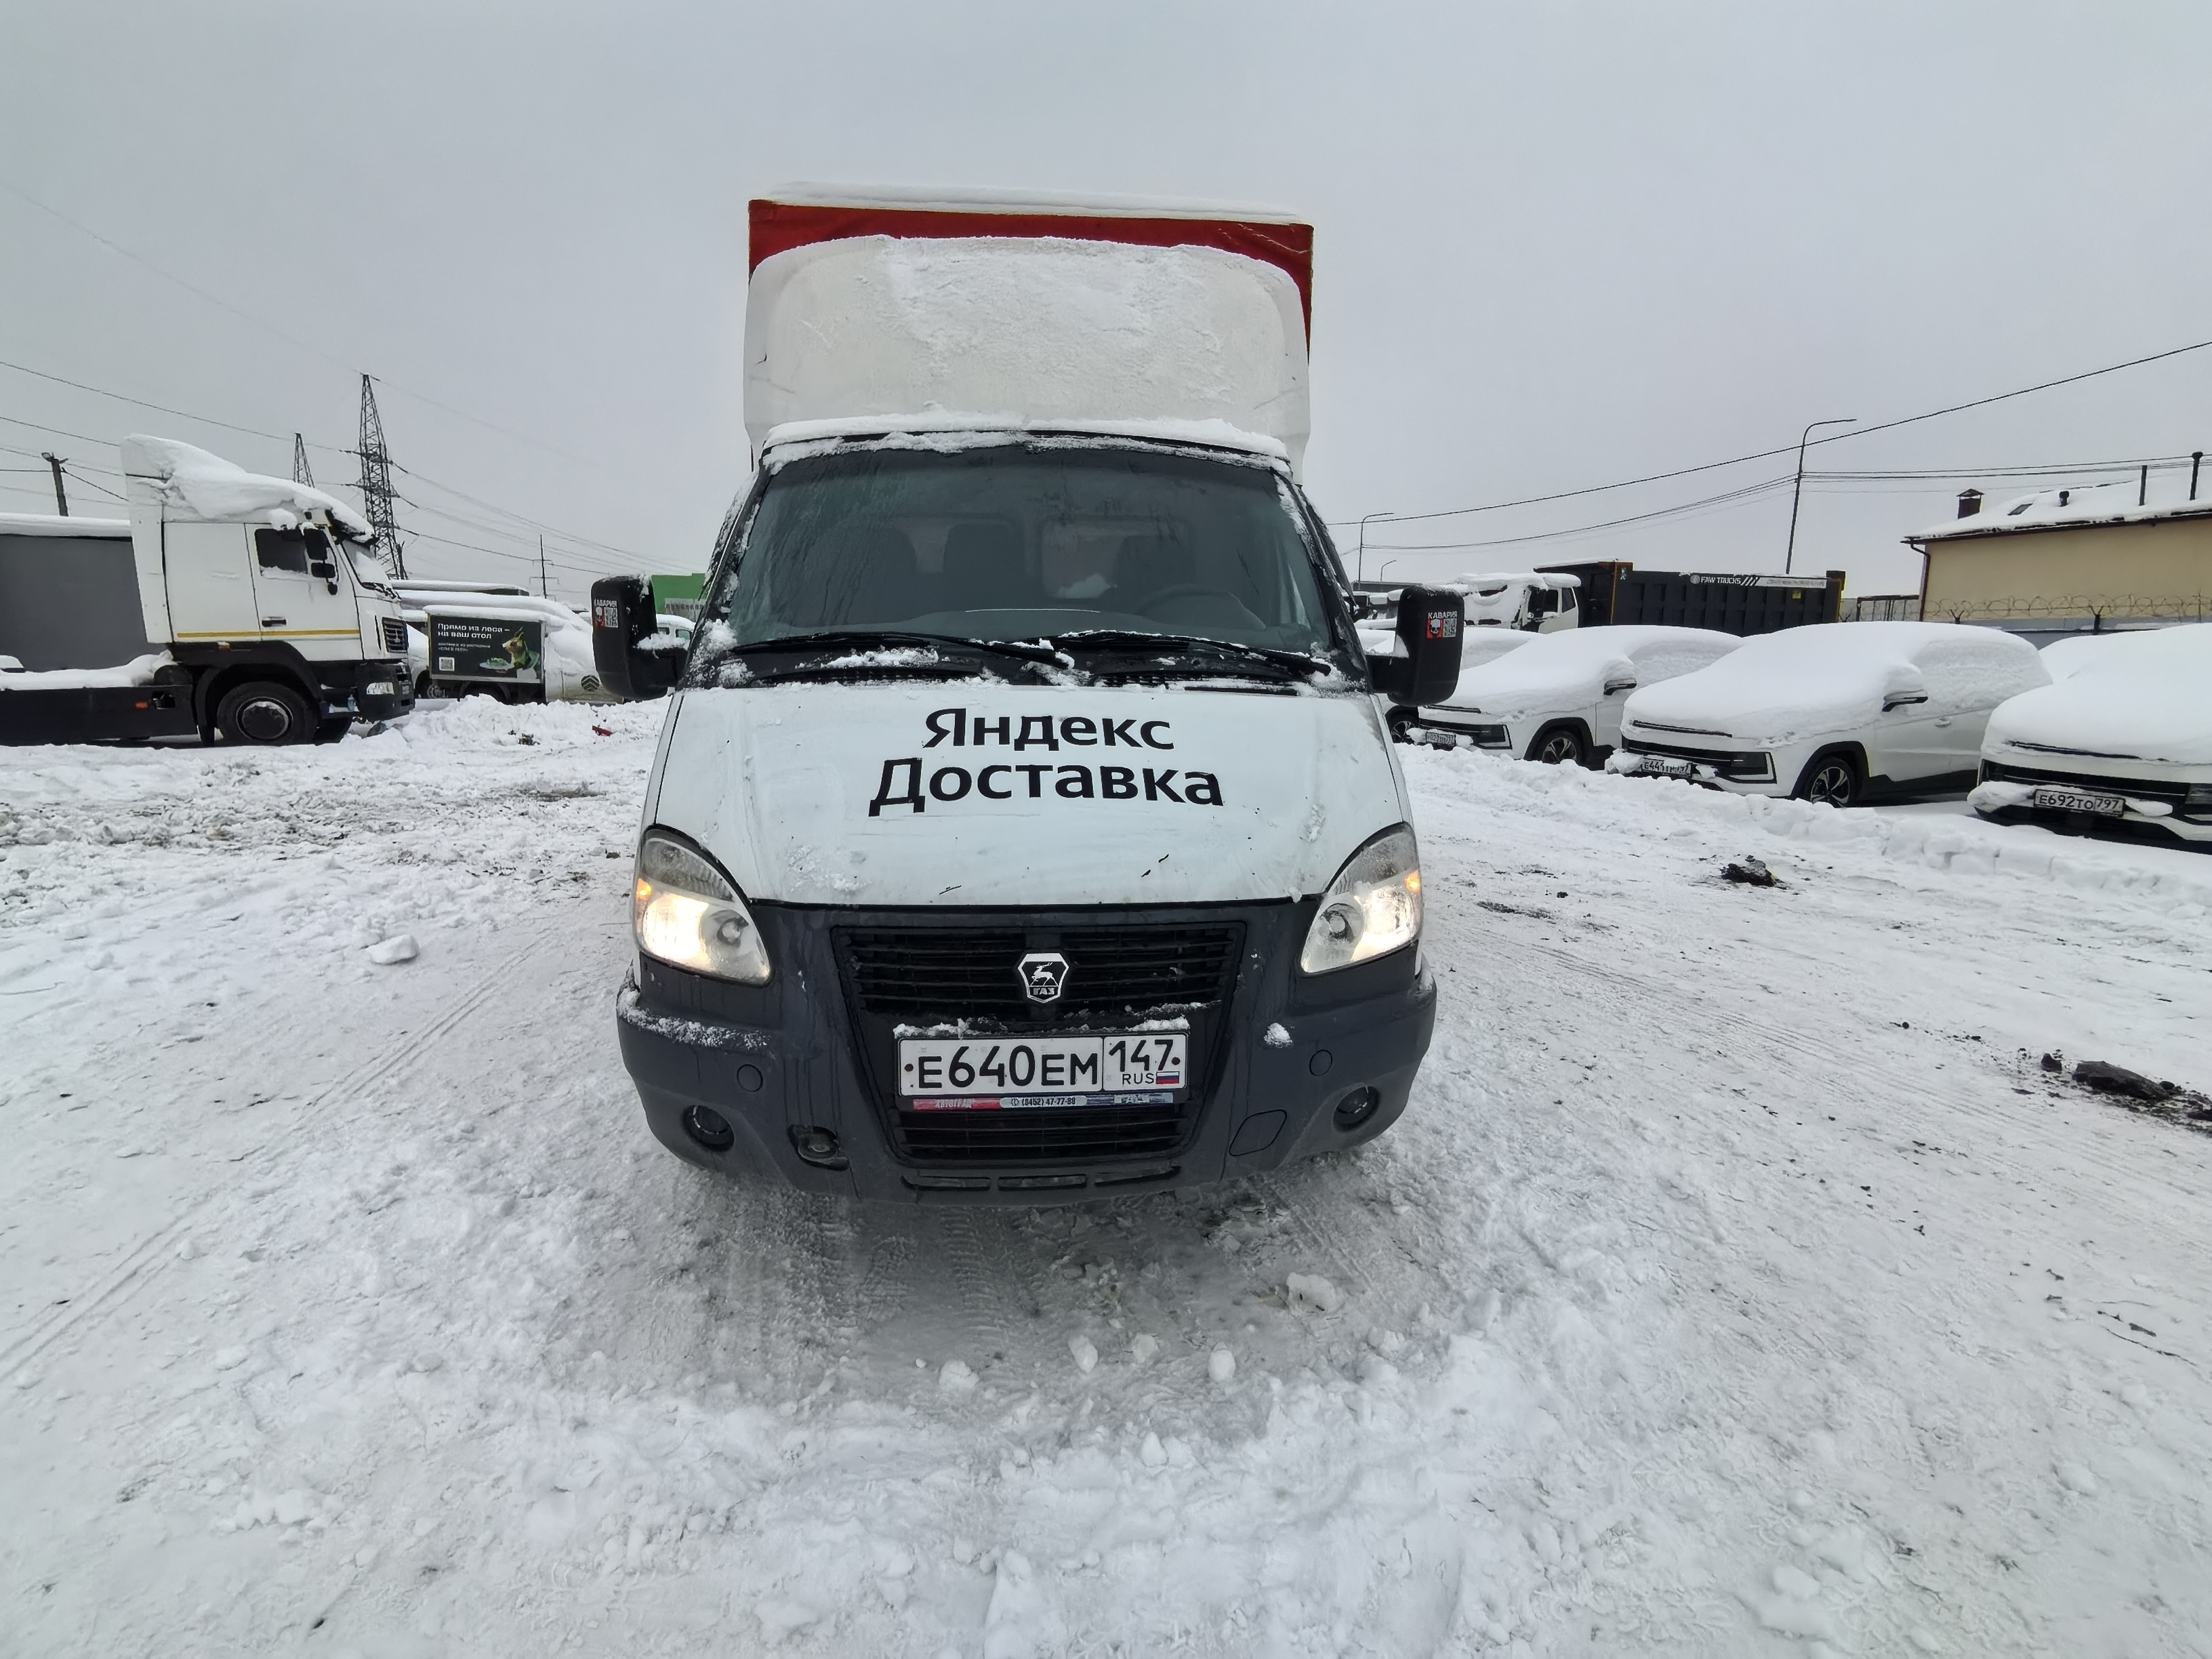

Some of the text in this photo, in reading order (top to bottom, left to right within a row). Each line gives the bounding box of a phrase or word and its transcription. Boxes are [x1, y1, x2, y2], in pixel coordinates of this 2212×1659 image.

[922, 708, 1174, 751] Яндекс
[868, 757, 1224, 817] Доставка
[2039, 794, 2119, 810] Е692ТО 797
[1033, 987, 1054, 996] ГАЗ
[918, 1039, 1174, 1089] Е640ЕМ 147
[1122, 1073, 1155, 1085] RUS
[1045, 1096, 1076, 1107] 47-77-88
